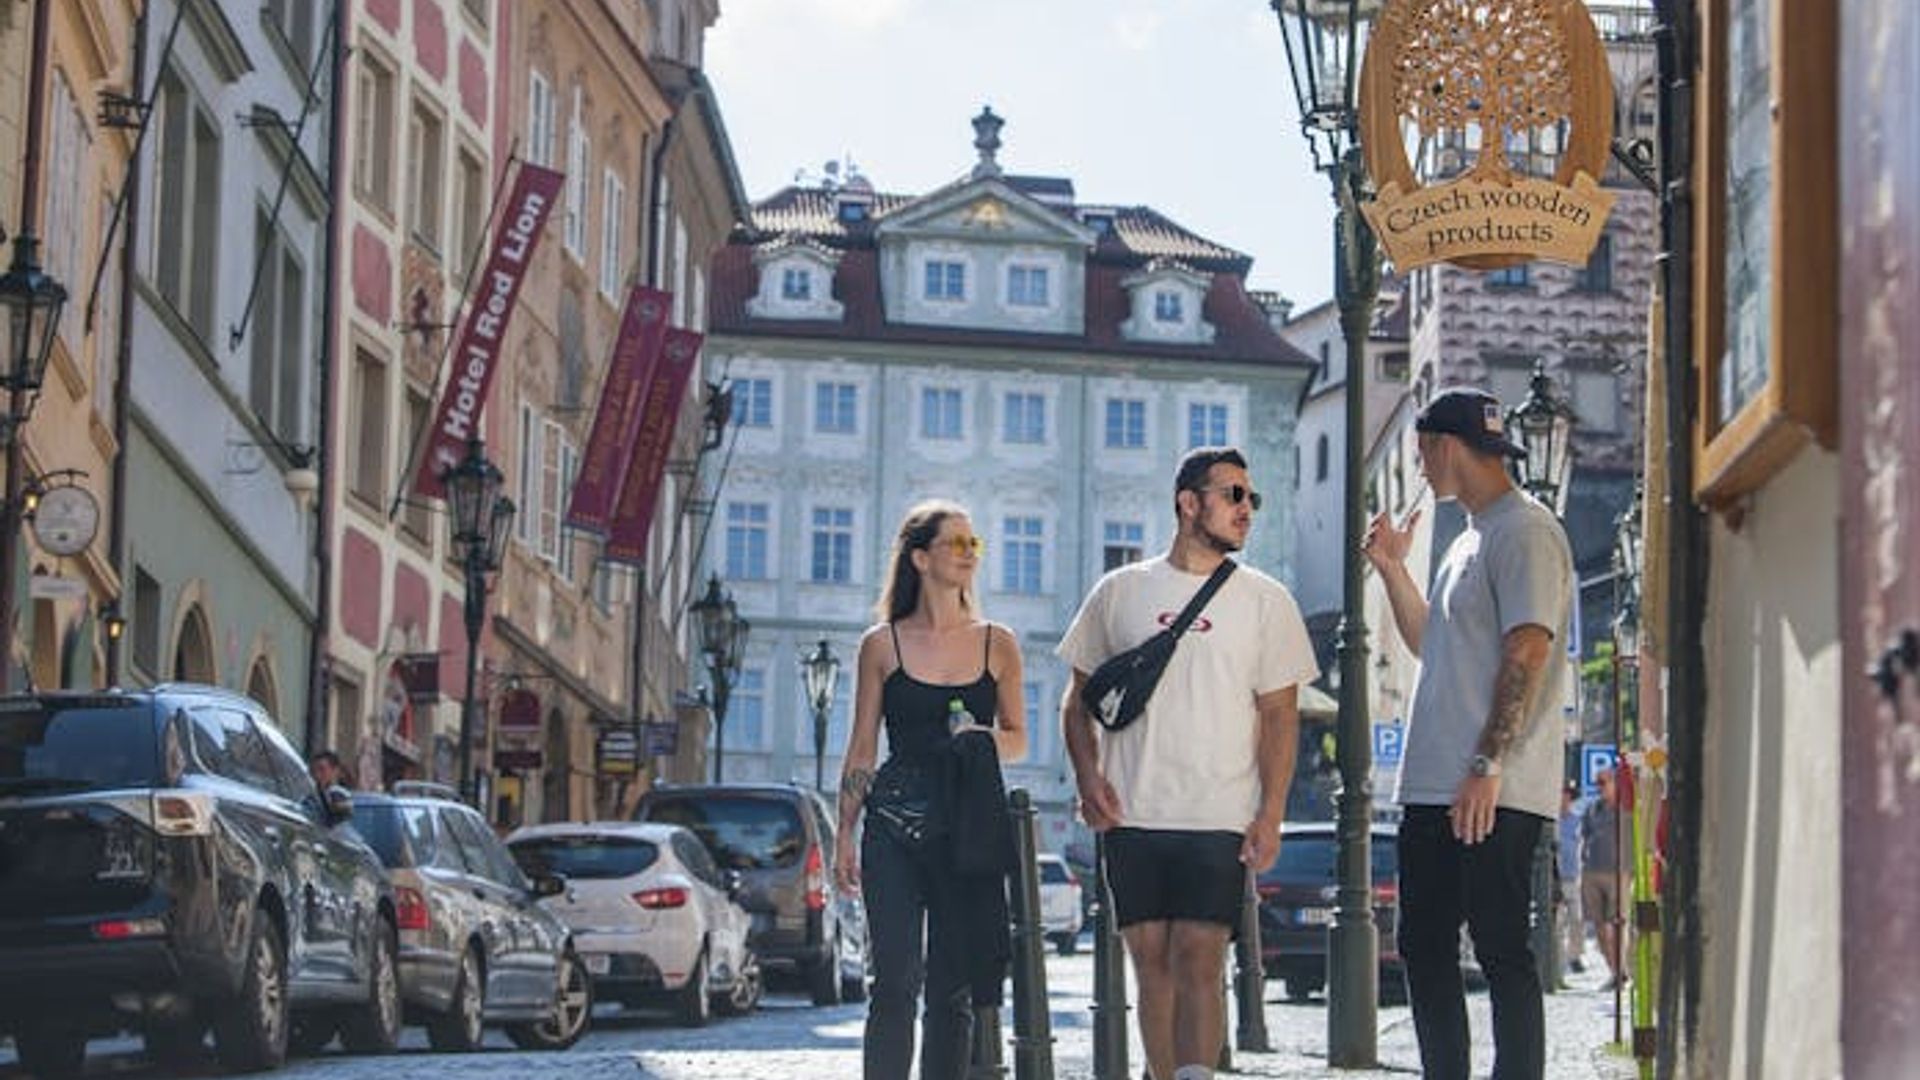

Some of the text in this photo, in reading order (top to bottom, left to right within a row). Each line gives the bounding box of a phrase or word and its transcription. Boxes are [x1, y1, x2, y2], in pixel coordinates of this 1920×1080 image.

[1387, 189, 1591, 234] Czech wooden
[1427, 218, 1554, 251] products
[443, 192, 546, 440] Hotel Red Lion
[1380, 728, 1398, 753] P
[1591, 752, 1612, 783] P
